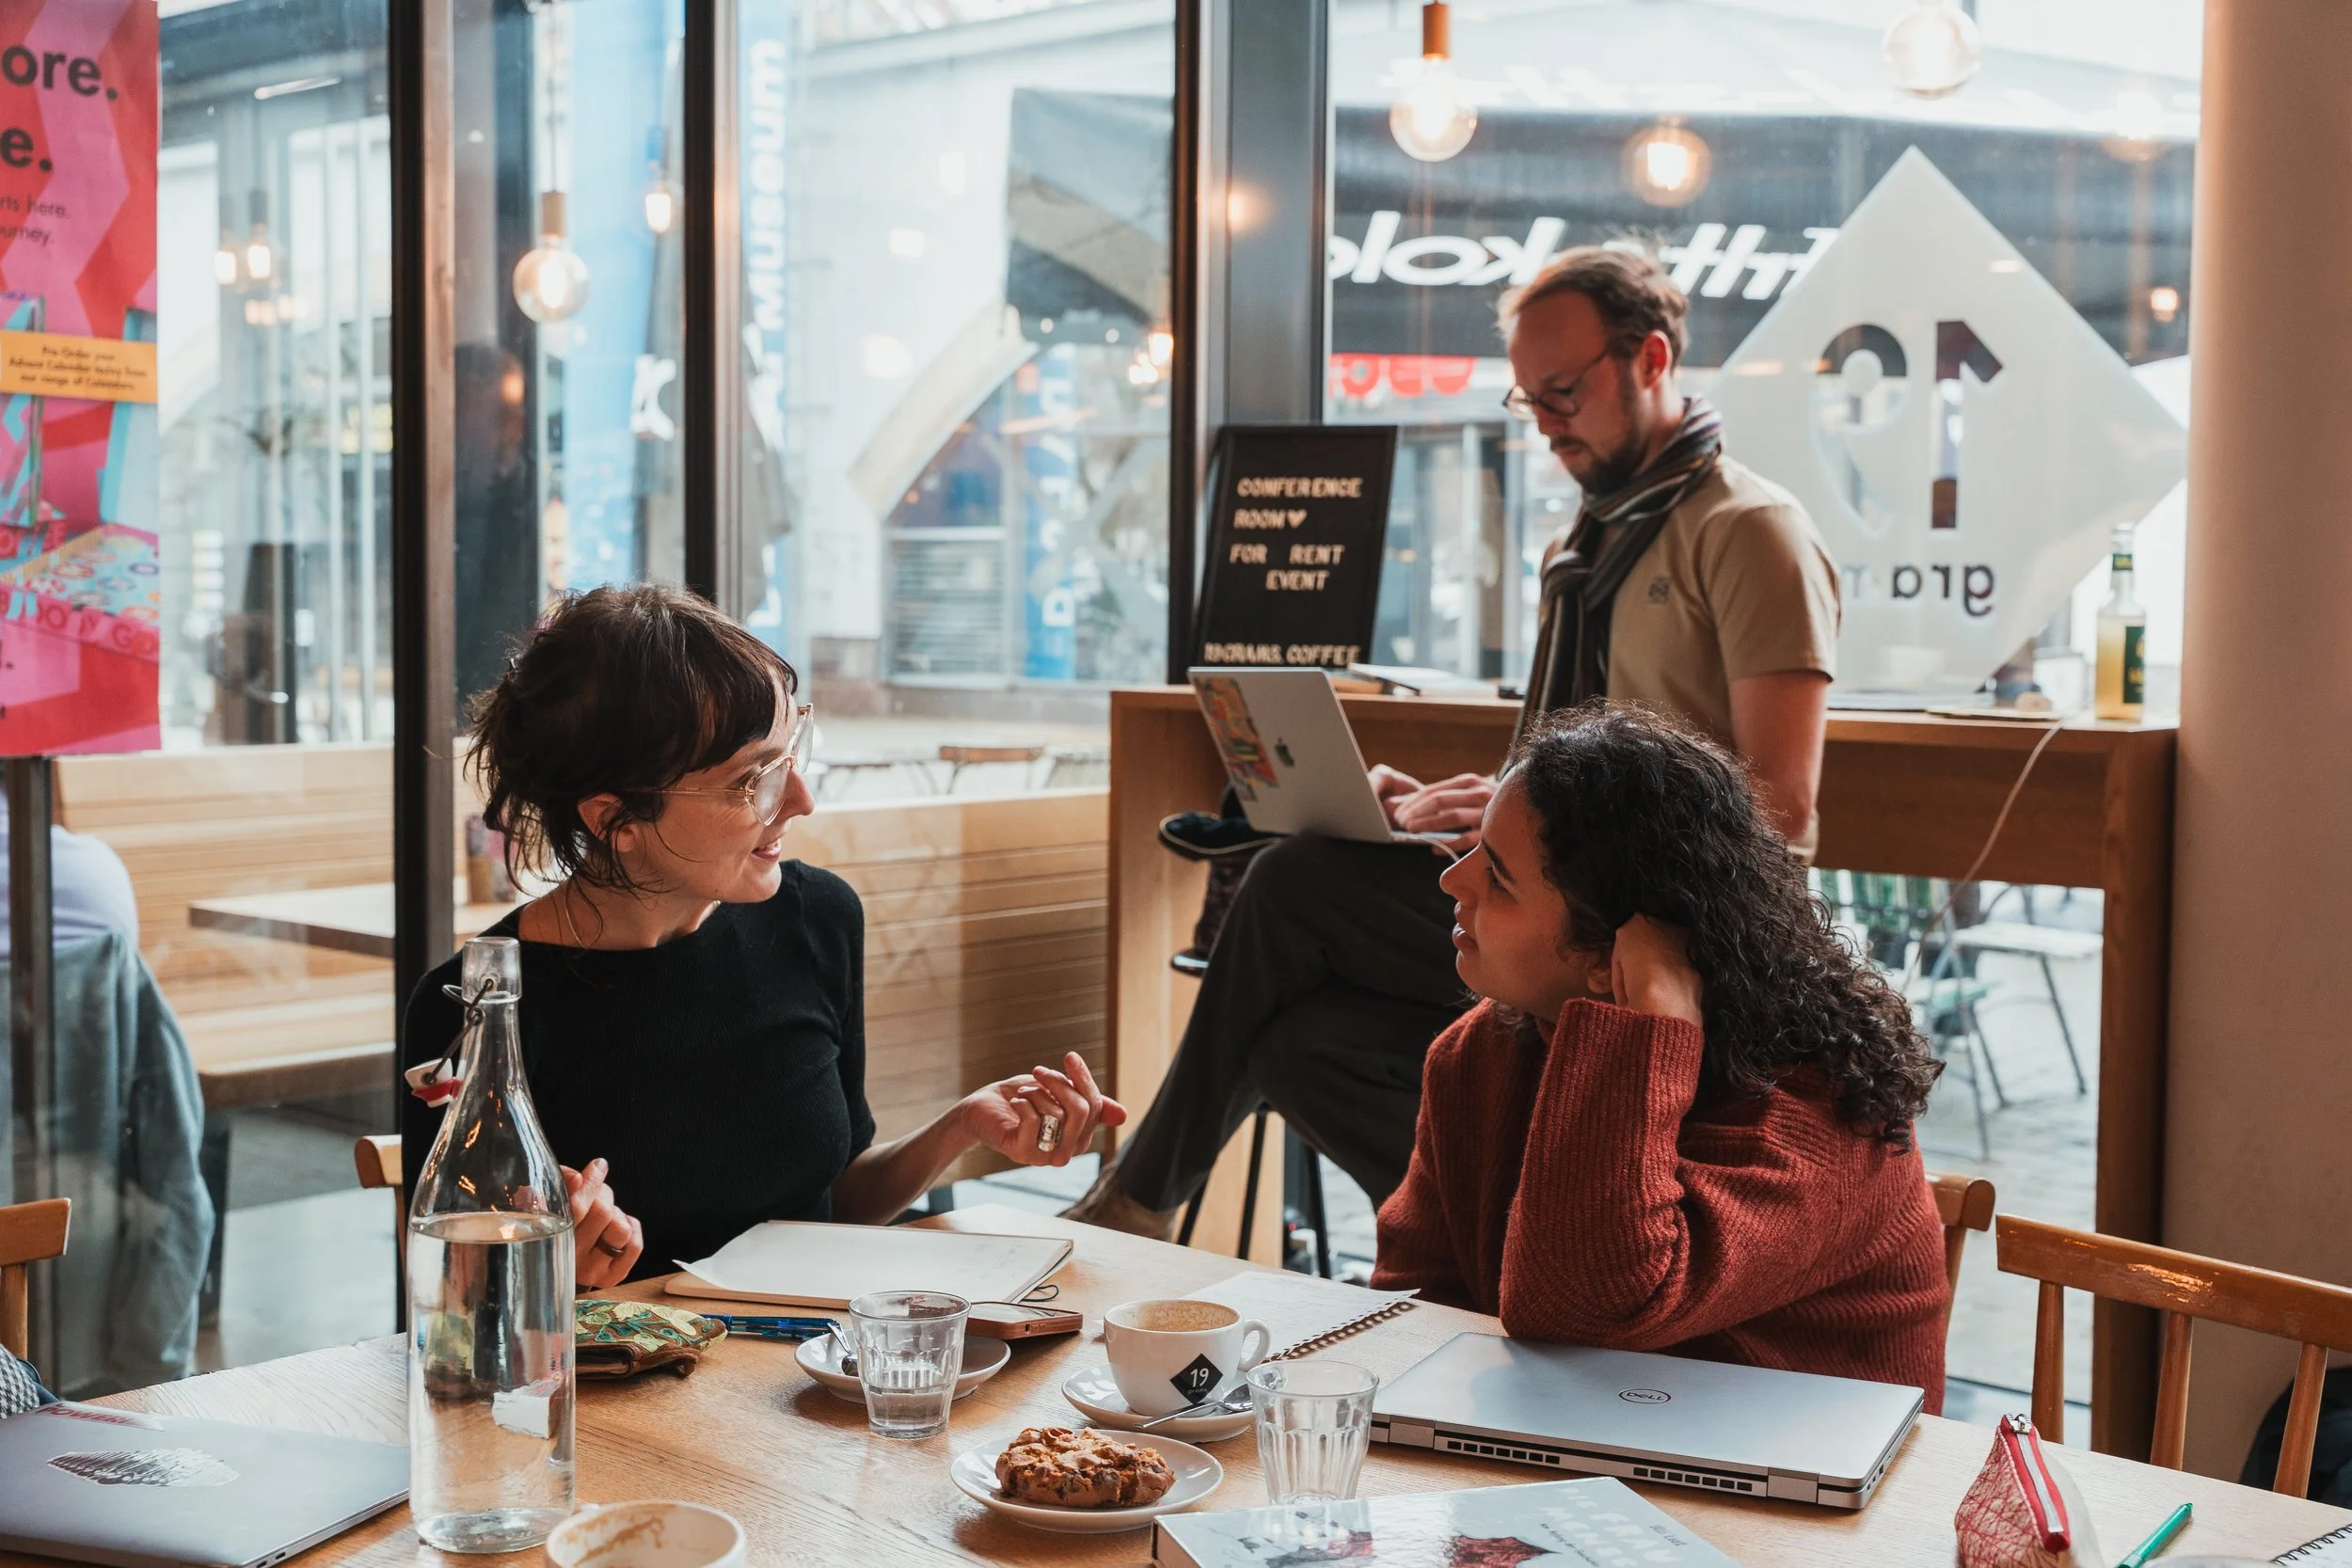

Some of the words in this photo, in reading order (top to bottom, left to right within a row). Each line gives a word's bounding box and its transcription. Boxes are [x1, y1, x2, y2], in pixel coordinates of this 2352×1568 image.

[3, 45, 119, 101] ore.
[0, 129, 54, 171] e.
[1236, 477, 1363, 498] CONFERENCE
[1232, 509, 1286, 529] ROOM
[1229, 544, 1267, 563] FOR
[1289, 544, 1345, 564] RENT
[1265, 570, 1329, 591] EVENT
[1286, 644, 1361, 665] COFFEE
[1190, 1368, 1209, 1387] 19
